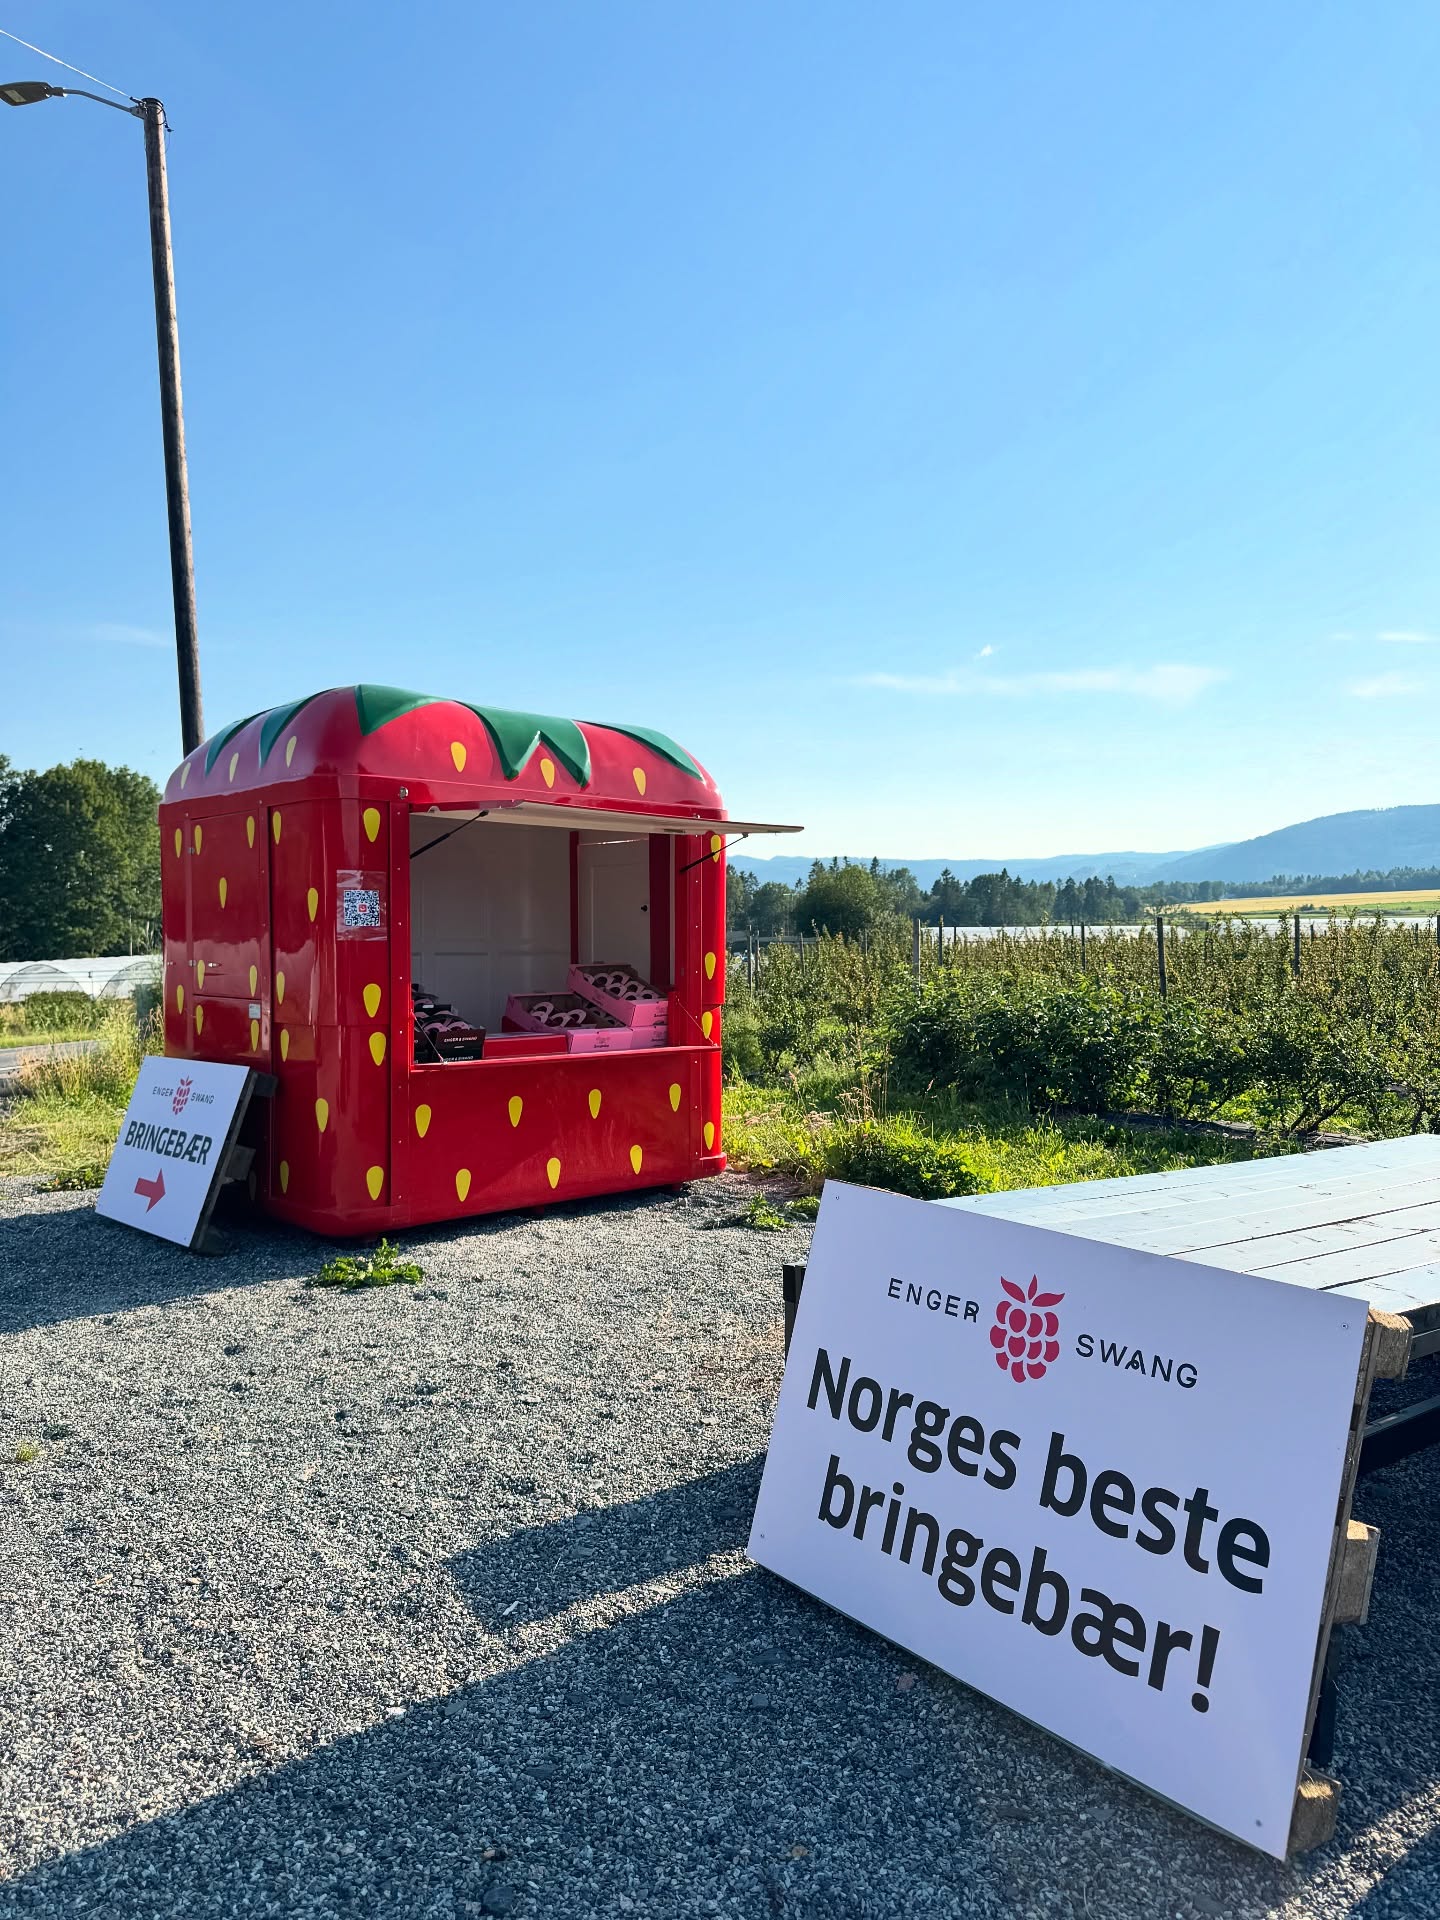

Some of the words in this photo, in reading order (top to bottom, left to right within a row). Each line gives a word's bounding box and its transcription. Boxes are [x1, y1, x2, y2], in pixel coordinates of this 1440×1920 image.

[124, 1120, 213, 1166] BRINGEBÆR
[152, 1086, 174, 1097] ENGER
[190, 1092, 215, 1105] SWANG
[887, 1277, 980, 1324] ENGER
[1075, 1333, 1198, 1389] SWANG
[806, 1347, 1022, 1491] Norges
[1038, 1431, 1271, 1595] beste
[817, 1453, 1221, 1714] bringebær!
